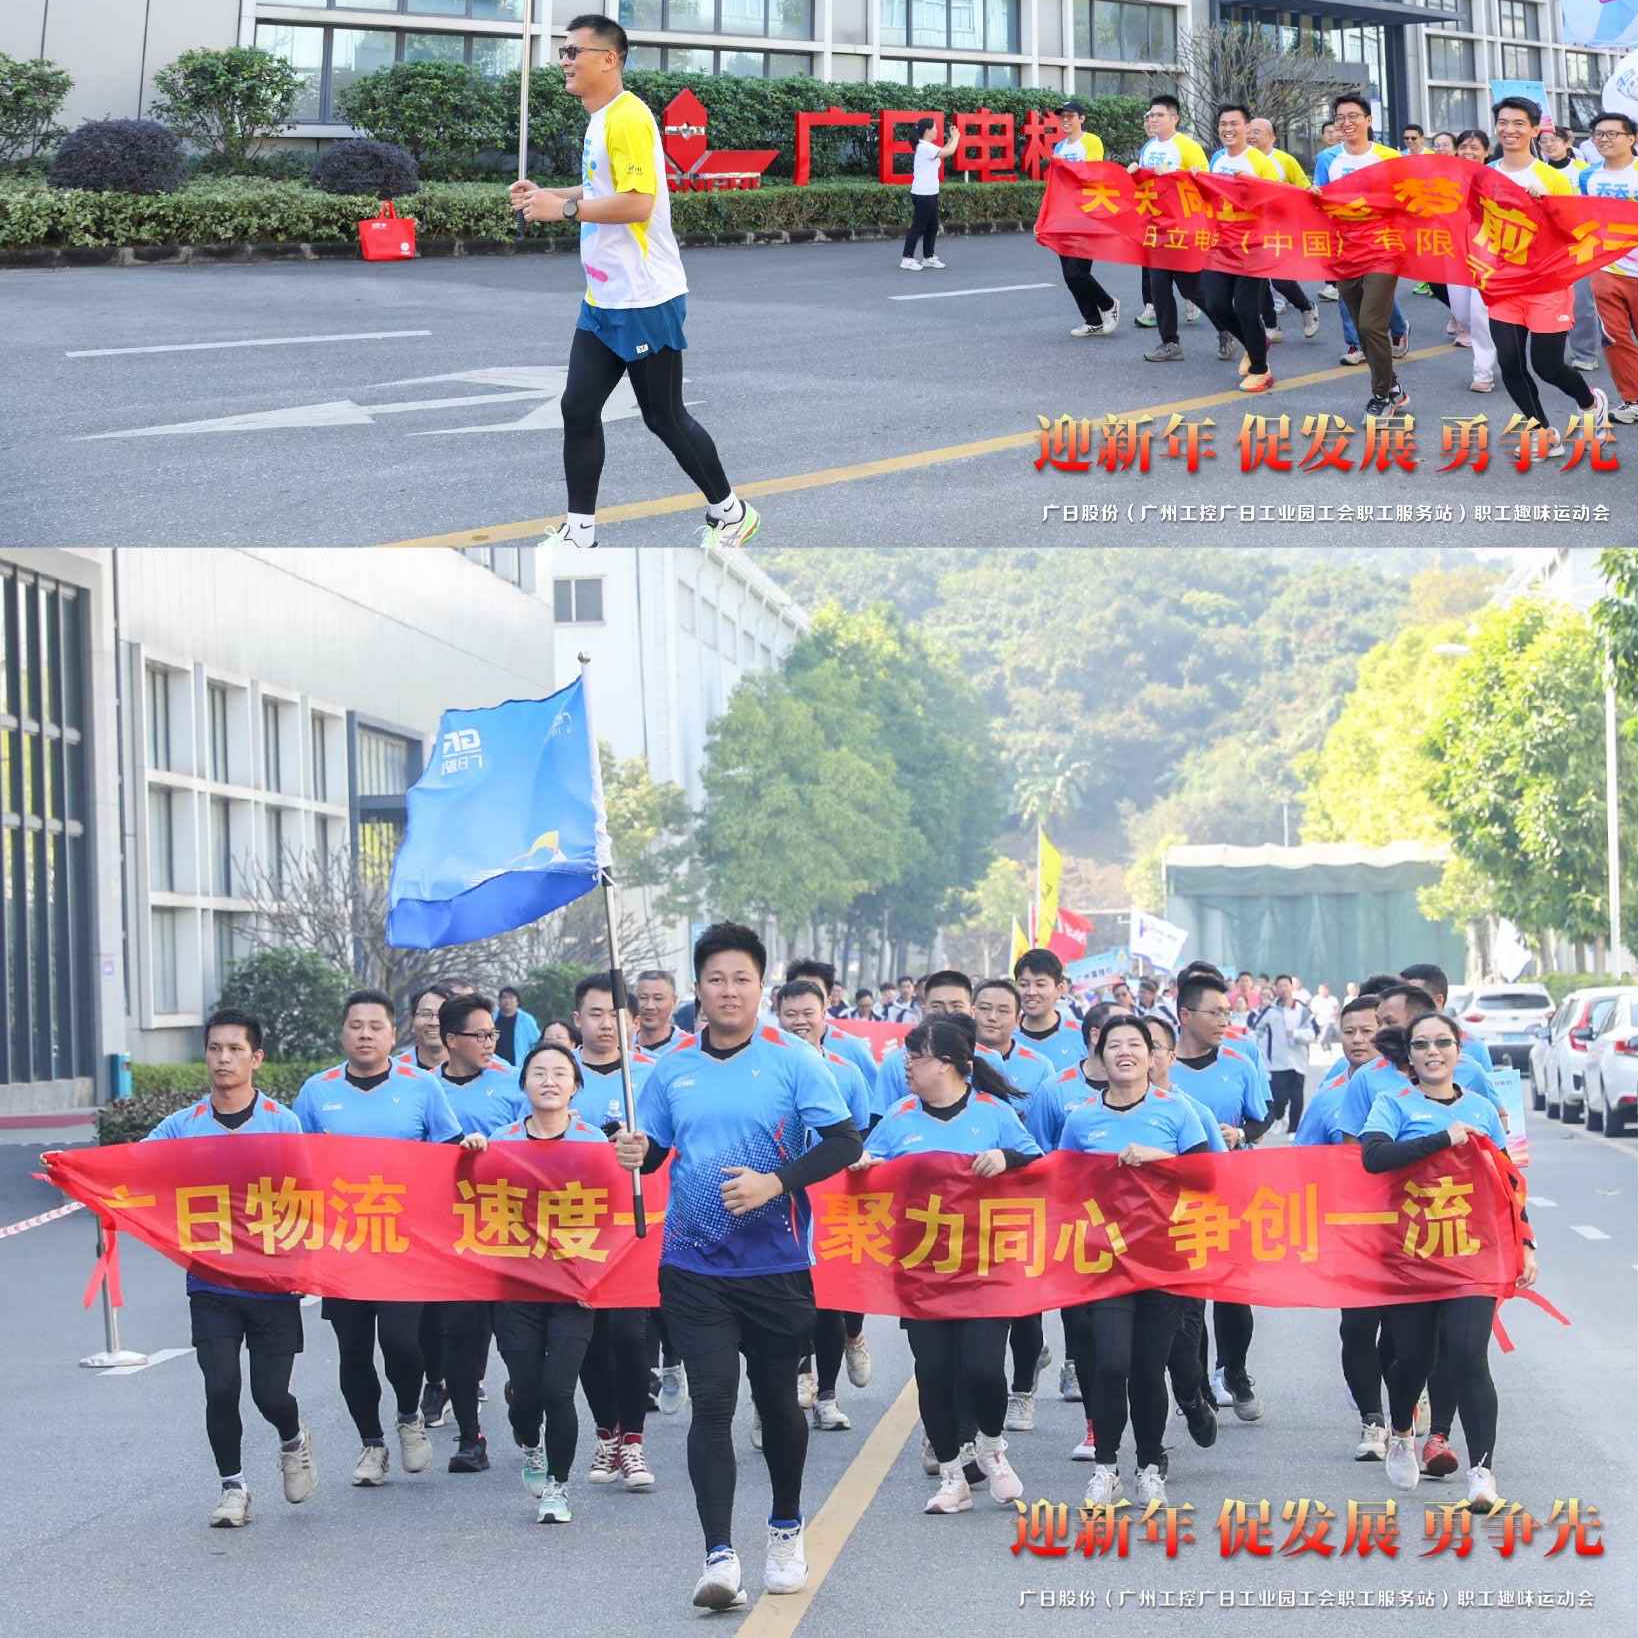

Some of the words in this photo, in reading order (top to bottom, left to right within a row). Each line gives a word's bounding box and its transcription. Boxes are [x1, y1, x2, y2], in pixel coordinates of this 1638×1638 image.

[817, 1191, 1128, 1278] 聚力同心
[1167, 1177, 1481, 1270] 争创一流
